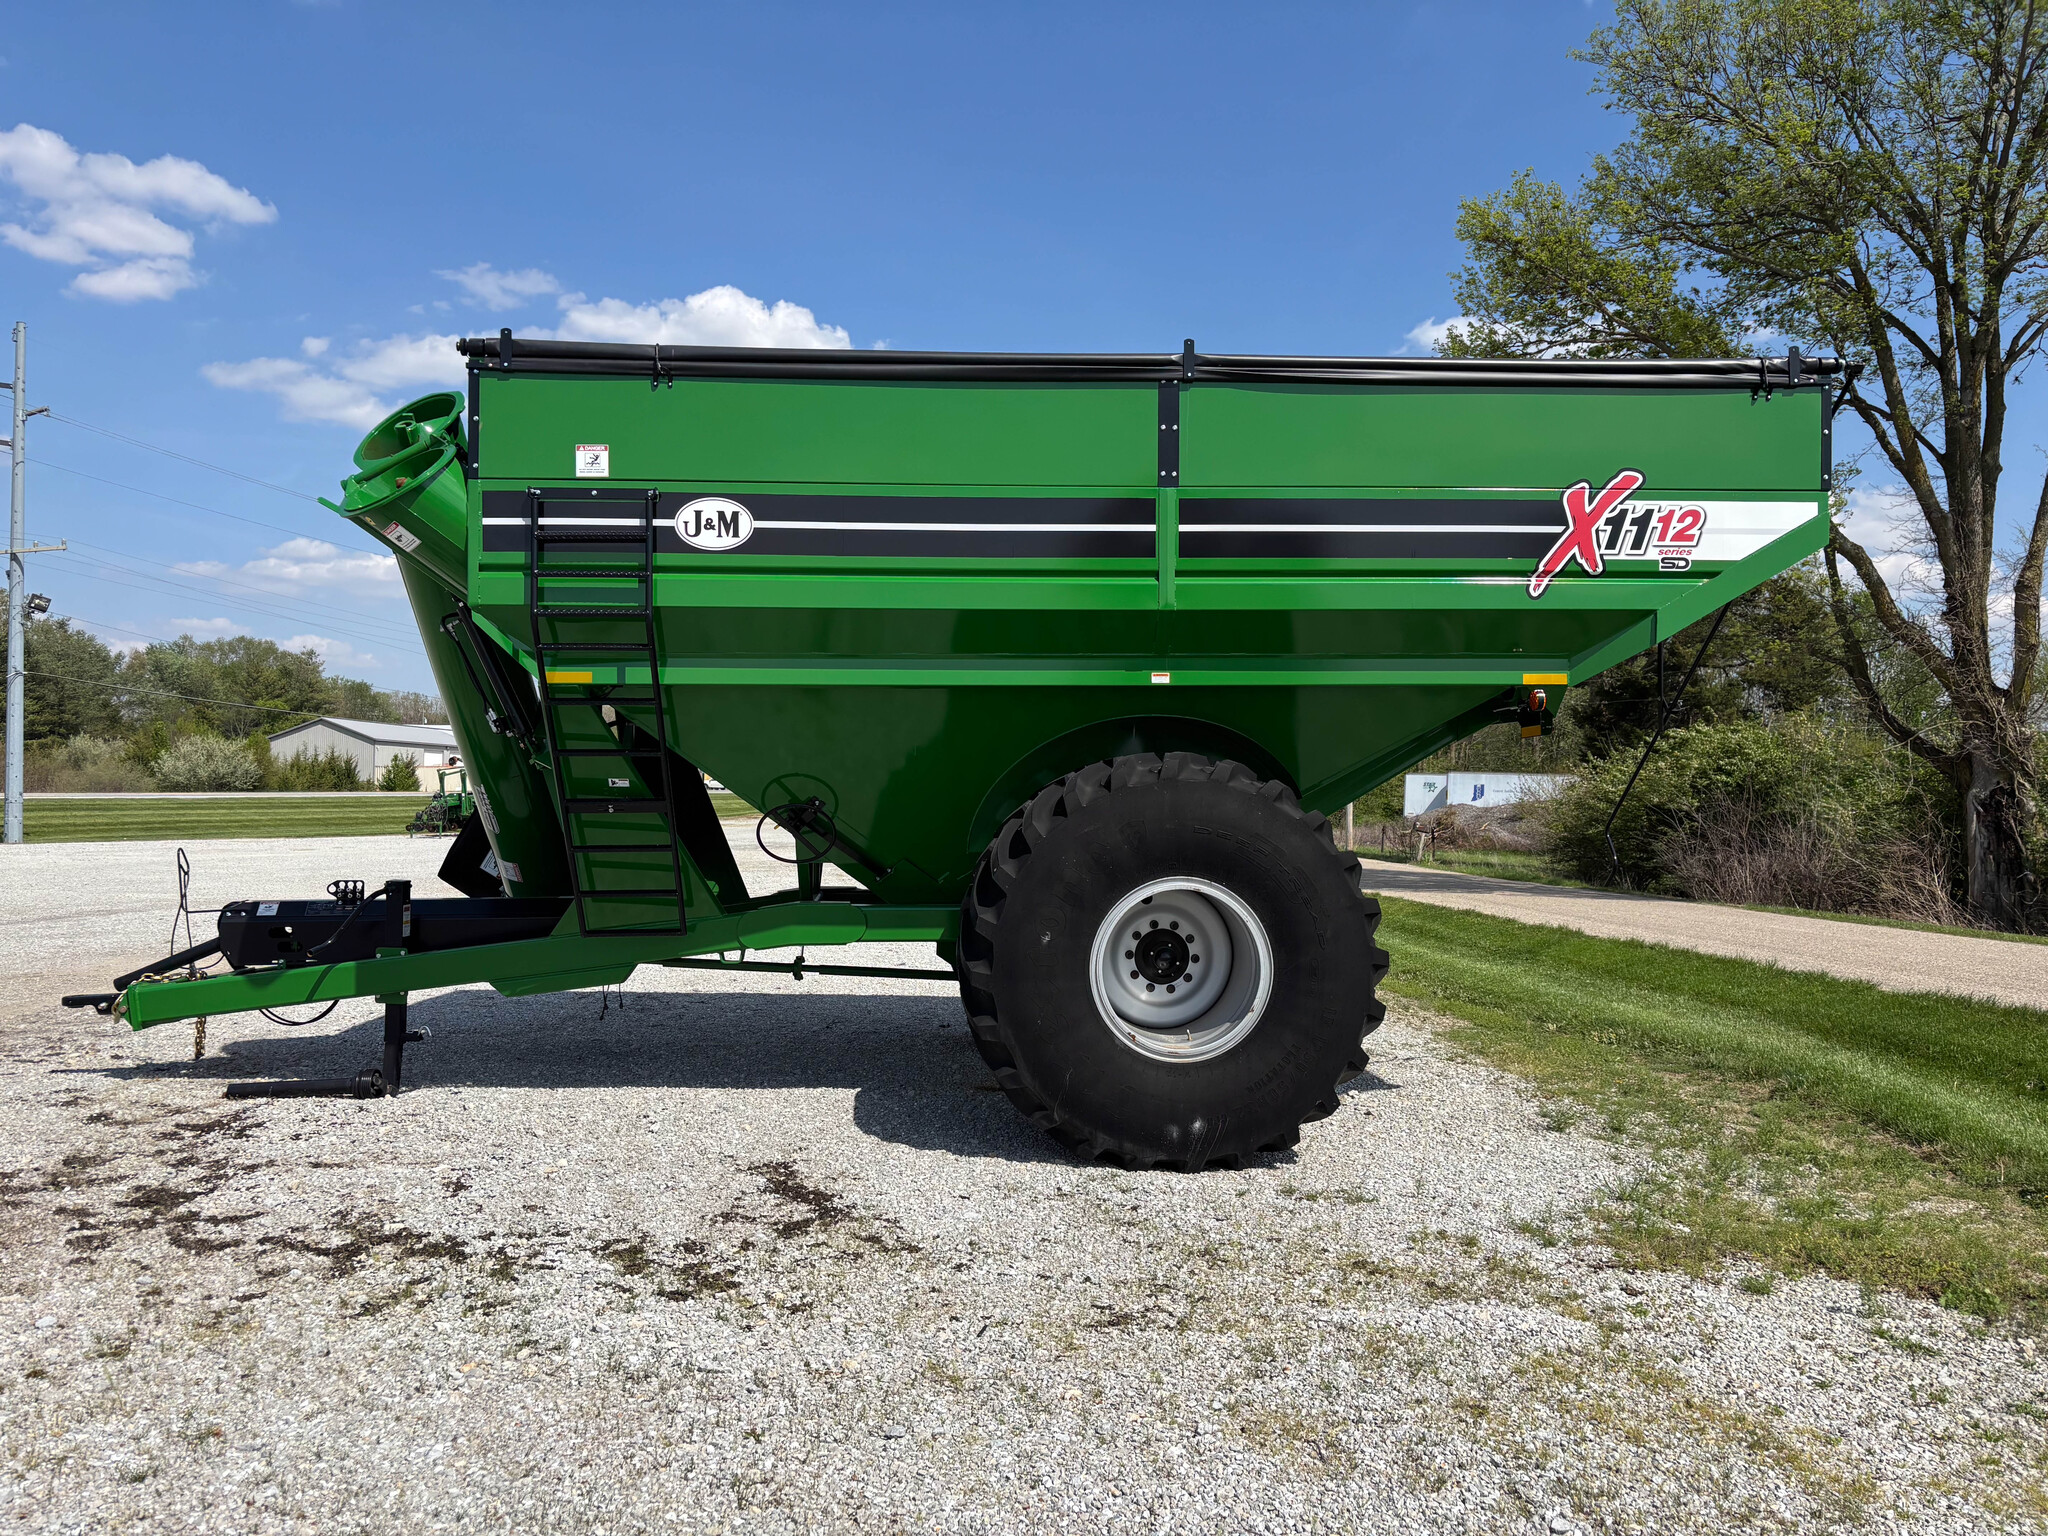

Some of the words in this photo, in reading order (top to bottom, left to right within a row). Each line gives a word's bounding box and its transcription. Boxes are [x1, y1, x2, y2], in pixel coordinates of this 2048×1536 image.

[683, 510, 740, 538] J&M
[1658, 547, 1692, 556] series
[1660, 557, 1690, 570] SD
